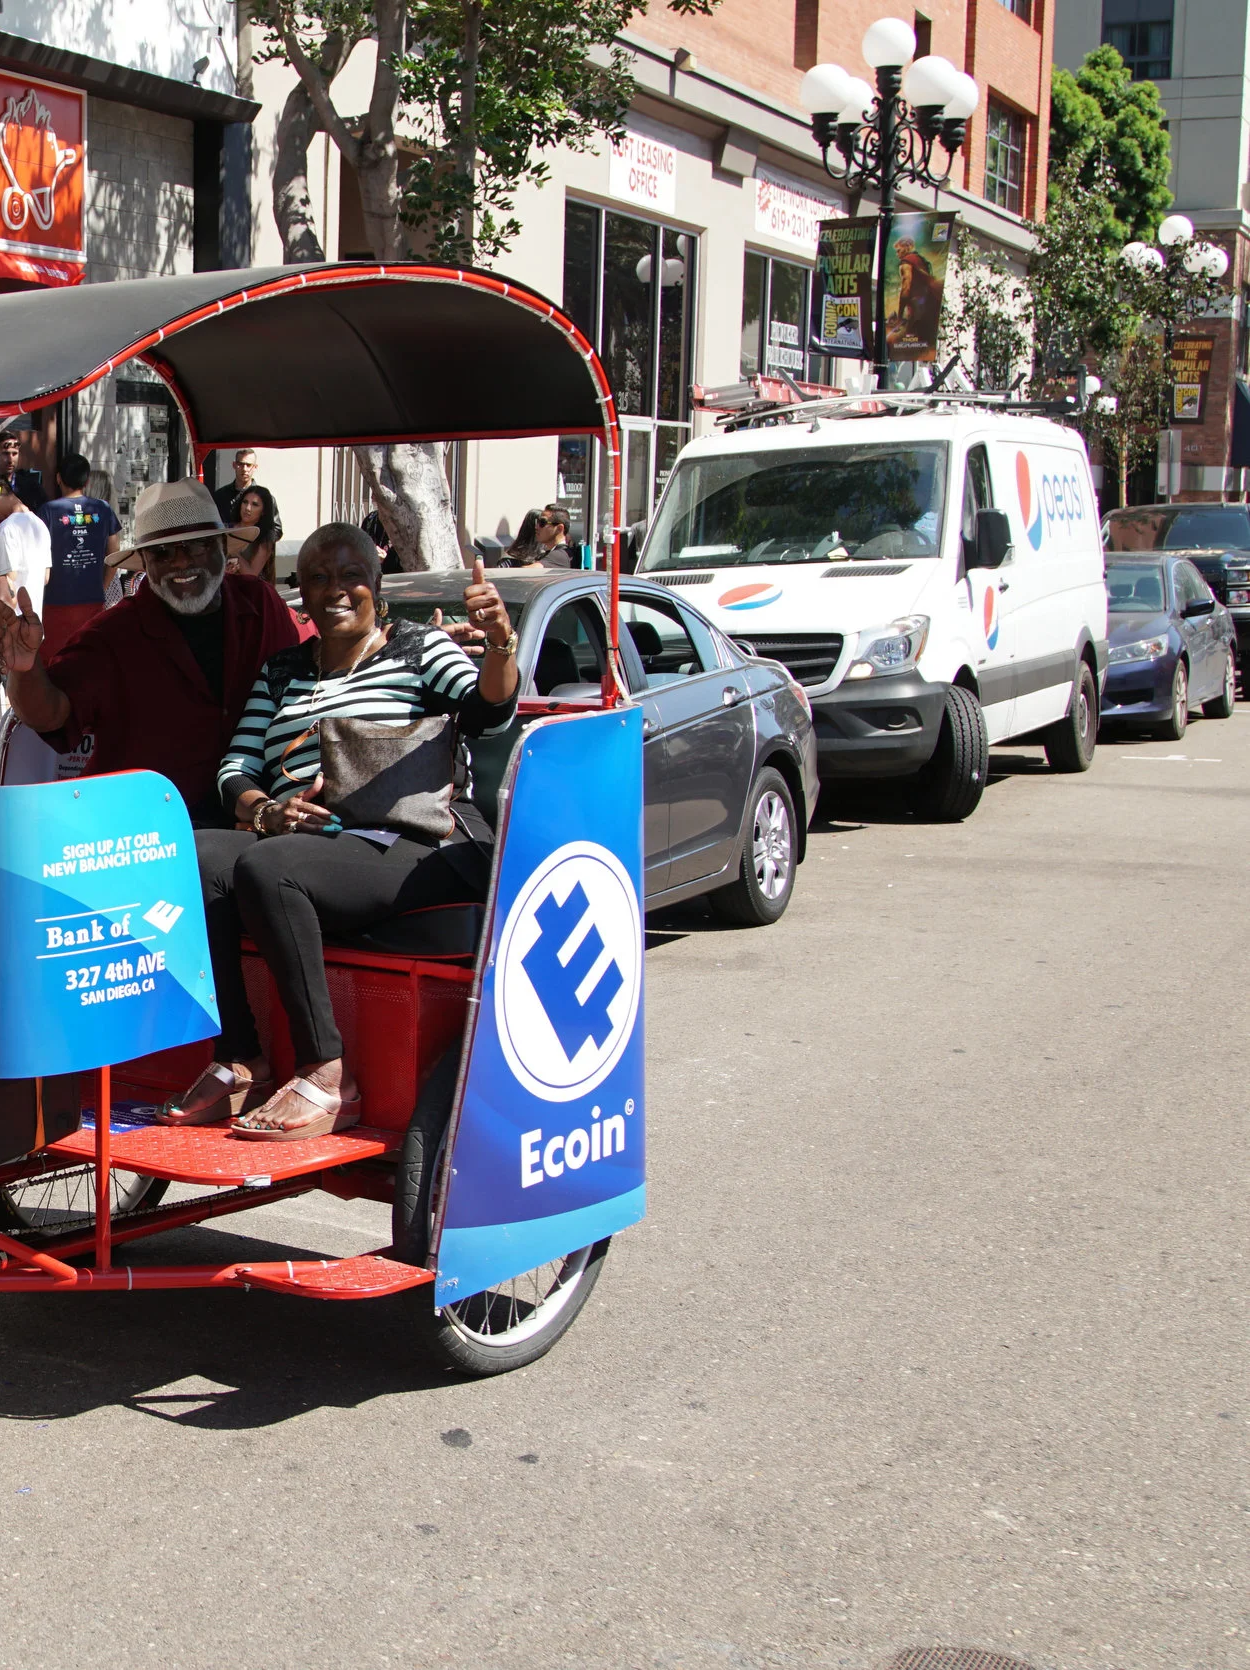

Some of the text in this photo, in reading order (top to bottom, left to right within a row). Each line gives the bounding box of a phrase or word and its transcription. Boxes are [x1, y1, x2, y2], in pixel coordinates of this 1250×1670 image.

[636, 140, 674, 175] LEASING
[628, 167, 657, 199] OFFICE
[835, 242, 853, 254] THE
[816, 253, 871, 274] POPULAR
[826, 274, 858, 295] ARTS
[824, 300, 838, 339] COMIC
[836, 303, 859, 317] CON
[1170, 359, 1210, 371] POPULAR
[1184, 350, 1199, 359] THE
[1176, 371, 1200, 383] ARTS
[1042, 462, 1086, 539] pepsi
[42, 842, 177, 878] NEW BRANCH TODAY!
[62, 831, 160, 861] SIGN UP AT OUR
[45, 919, 105, 949] Bank
[110, 913, 131, 938] of
[65, 950, 166, 991] 327 4th AVE
[80, 978, 155, 1006] SAN DIEGO, CA
